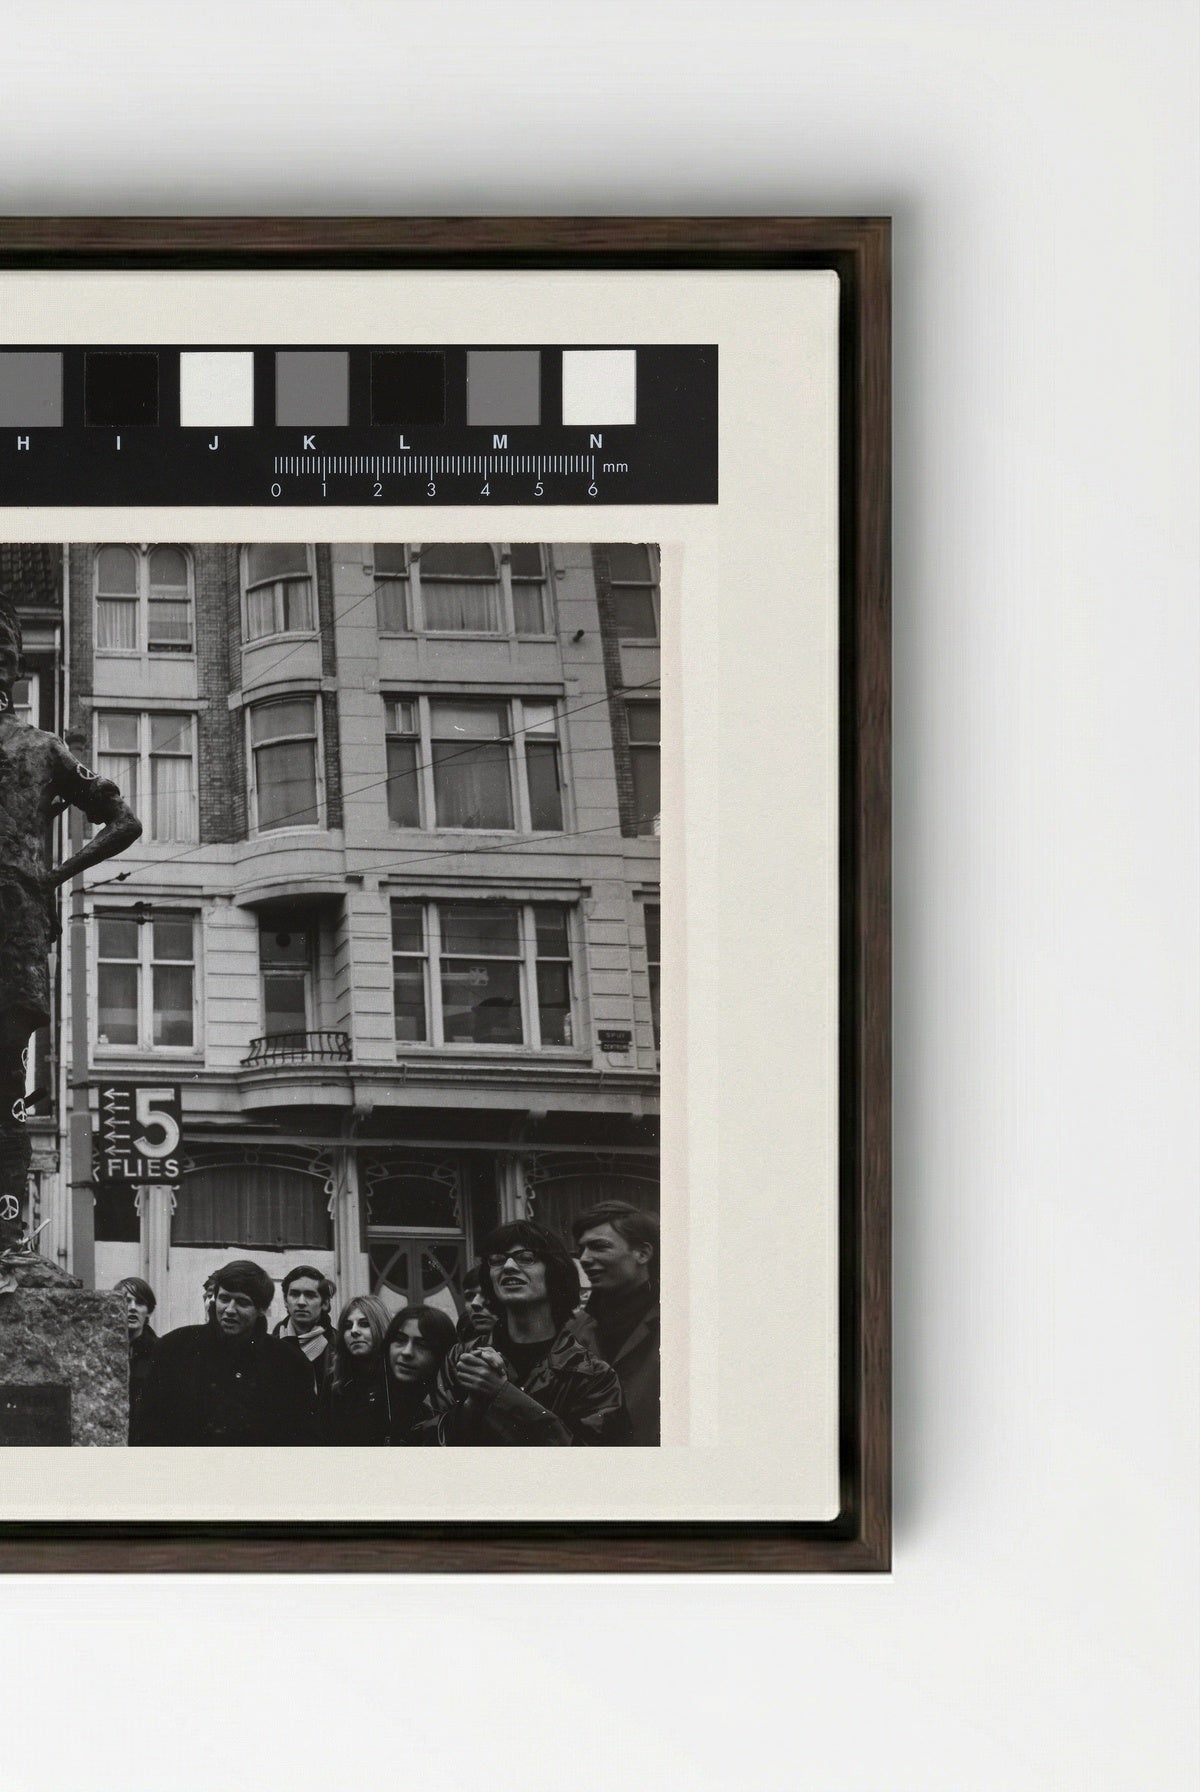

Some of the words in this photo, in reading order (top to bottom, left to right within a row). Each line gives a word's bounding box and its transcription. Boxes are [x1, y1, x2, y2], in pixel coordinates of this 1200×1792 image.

[17, 435, 30, 451] H
[208, 435, 219, 451] J
[303, 434, 317, 450] K
[399, 434, 411, 450] L
[493, 434, 508, 450] M
[589, 433, 603, 449] N
[602, 462, 629, 473] mm
[270, 482, 282, 498] 0
[373, 482, 383, 497] 2
[426, 482, 436, 497] 3
[479, 482, 491, 497] 4
[533, 481, 544, 497] 5
[587, 481, 599, 498] 6
[133, 1087, 180, 1158] 5
[107, 1158, 180, 1178] FLIES
